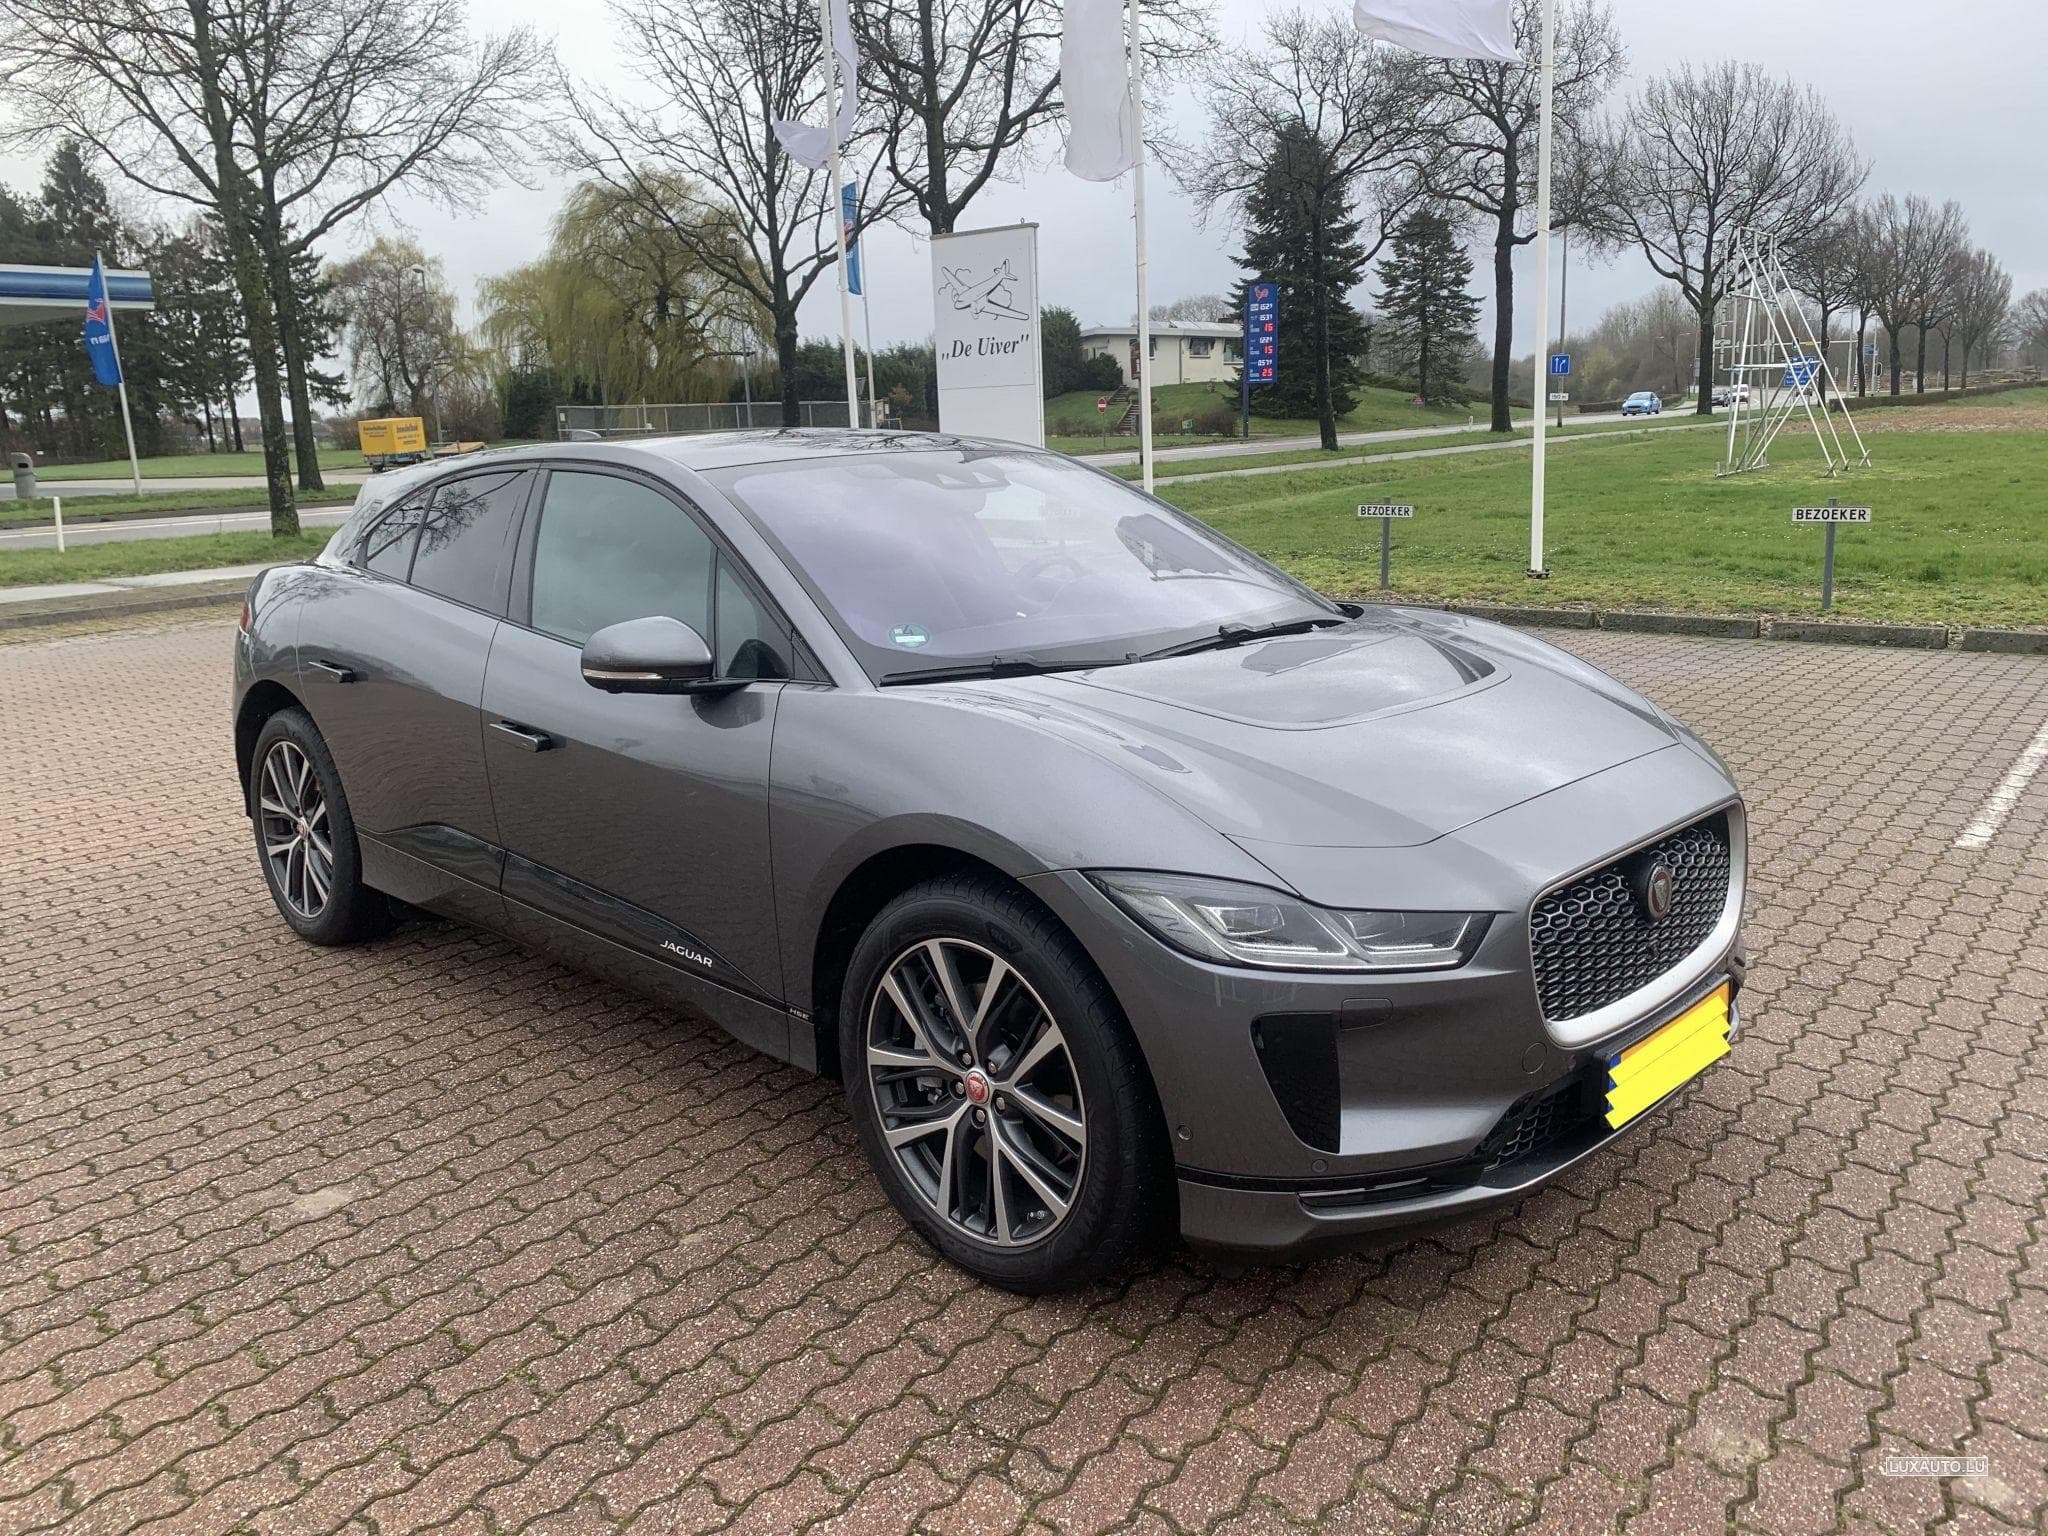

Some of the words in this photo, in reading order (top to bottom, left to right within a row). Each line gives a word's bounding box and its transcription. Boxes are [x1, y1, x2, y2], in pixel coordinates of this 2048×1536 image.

[1360, 506, 1410, 516] BEZOEKER
[1796, 509, 1867, 520] BEZOEKER
[660, 940, 713, 968] JAGUAR
